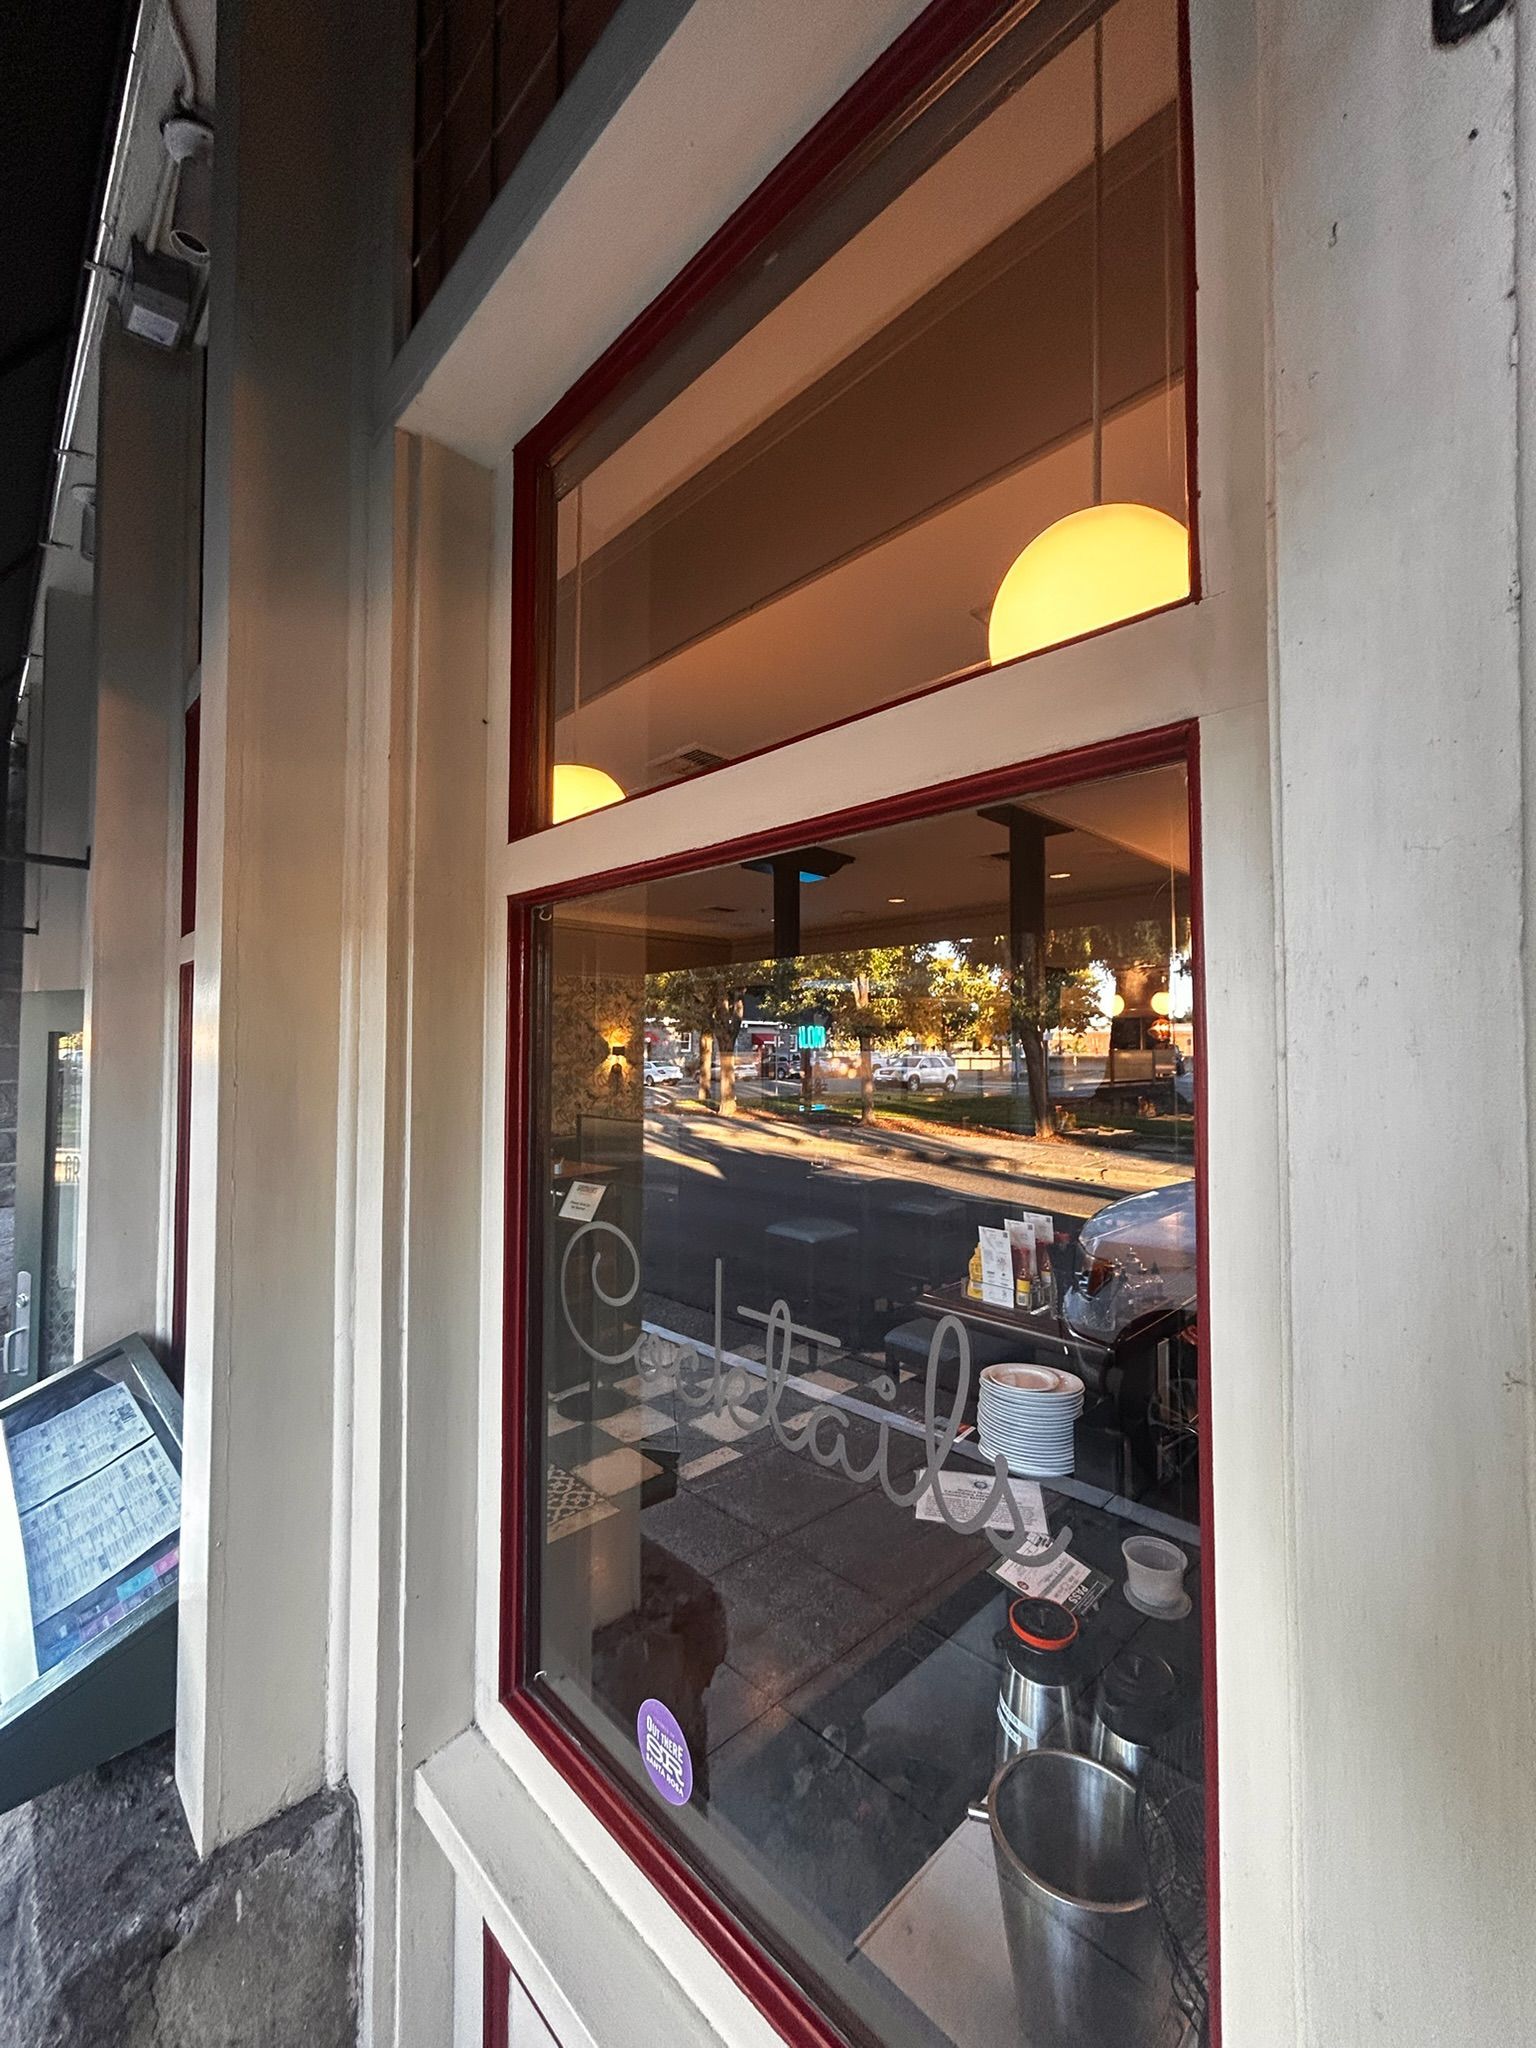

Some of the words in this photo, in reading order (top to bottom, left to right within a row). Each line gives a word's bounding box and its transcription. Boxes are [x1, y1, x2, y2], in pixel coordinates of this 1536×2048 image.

[561, 1221, 1073, 1567] Cocktails
[1068, 1584, 1089, 1605] PASS
[646, 1714, 660, 1740] OUT
[660, 1732, 684, 1764] THERE
[646, 1733, 684, 1788] SR
[646, 1751, 666, 1778] SANTA
[666, 1772, 684, 1798] ROSA
